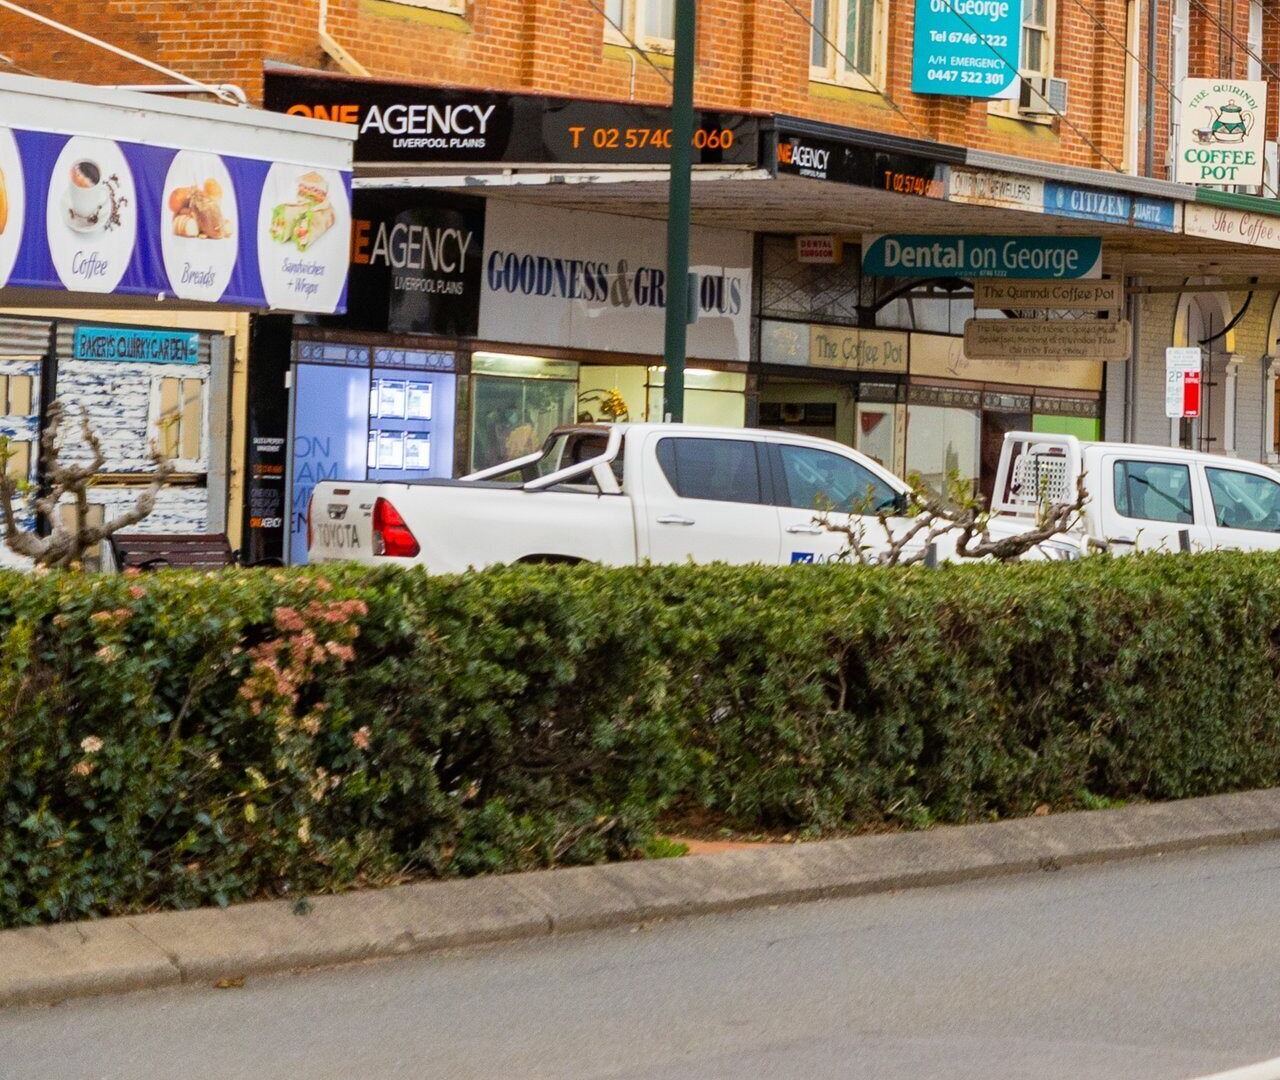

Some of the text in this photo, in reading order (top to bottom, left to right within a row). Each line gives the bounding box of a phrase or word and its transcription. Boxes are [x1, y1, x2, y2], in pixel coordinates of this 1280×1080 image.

[929, 30, 1008, 47] Tel 6746 1222
[928, 55, 1006, 69] A/H EMERGENCY
[927, 69, 1004, 85] 0447 522 301
[1189, 84, 1259, 110] THE QUIRINDI
[360, 104, 496, 135] AGENCY
[393, 138, 486, 149] LIVERPOOL PLAINS
[568, 126, 734, 150] T 02 5740 060
[777, 142, 830, 170] NE AGENCY
[1184, 148, 1256, 166] COFFEE
[893, 172, 904, 193] 02
[1200, 165, 1239, 181] POT
[1070, 189, 1126, 216] CITIZEN
[1212, 208, 1234, 234] The
[1239, 212, 1274, 245] Coffee
[369, 221, 473, 274] AGENCY
[800, 240, 832, 248] DENTAL
[72, 250, 108, 280] Coffee
[281, 257, 325, 277] Sandwiches
[885, 239, 1079, 277] Dental on George
[181, 261, 216, 288] Breads
[394, 276, 464, 295] LIVERPOOL PLAINS
[487, 249, 742, 316] GOODNESS & GROUS
[983, 285, 1114, 302] The Quirindi Coffee Pot
[816, 334, 837, 359] The
[842, 336, 879, 366] Coffee
[883, 340, 903, 364] Pot
[1168, 371, 1183, 383] 2P
[317, 522, 360, 549] TOYOTA
